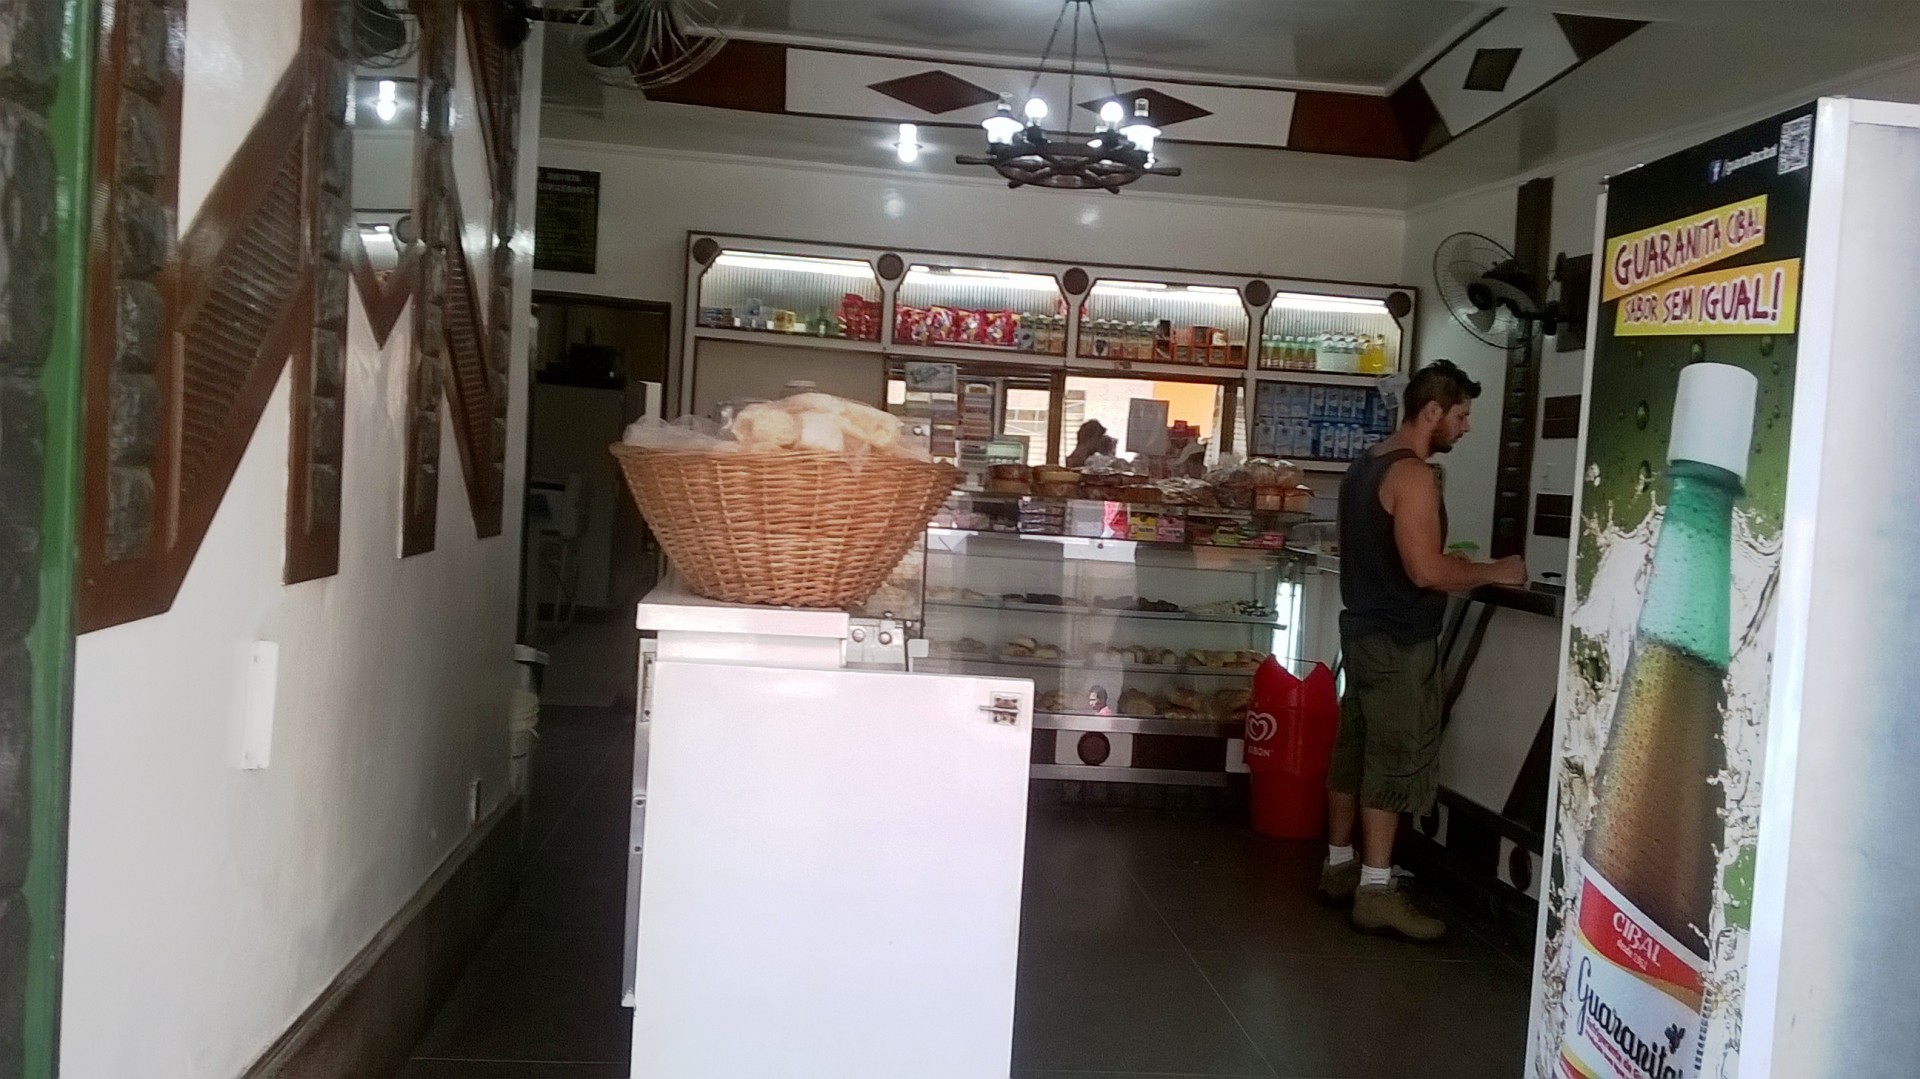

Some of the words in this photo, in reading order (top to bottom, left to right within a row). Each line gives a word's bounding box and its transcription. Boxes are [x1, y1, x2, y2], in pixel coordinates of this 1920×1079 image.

[1614, 217, 1721, 285] GUARANITA
[1624, 295, 1657, 323] SABOR
[1663, 288, 1693, 323] SEM
[1698, 272, 1781, 321] IGUAL!
[1613, 912, 1661, 967] CIBAL
